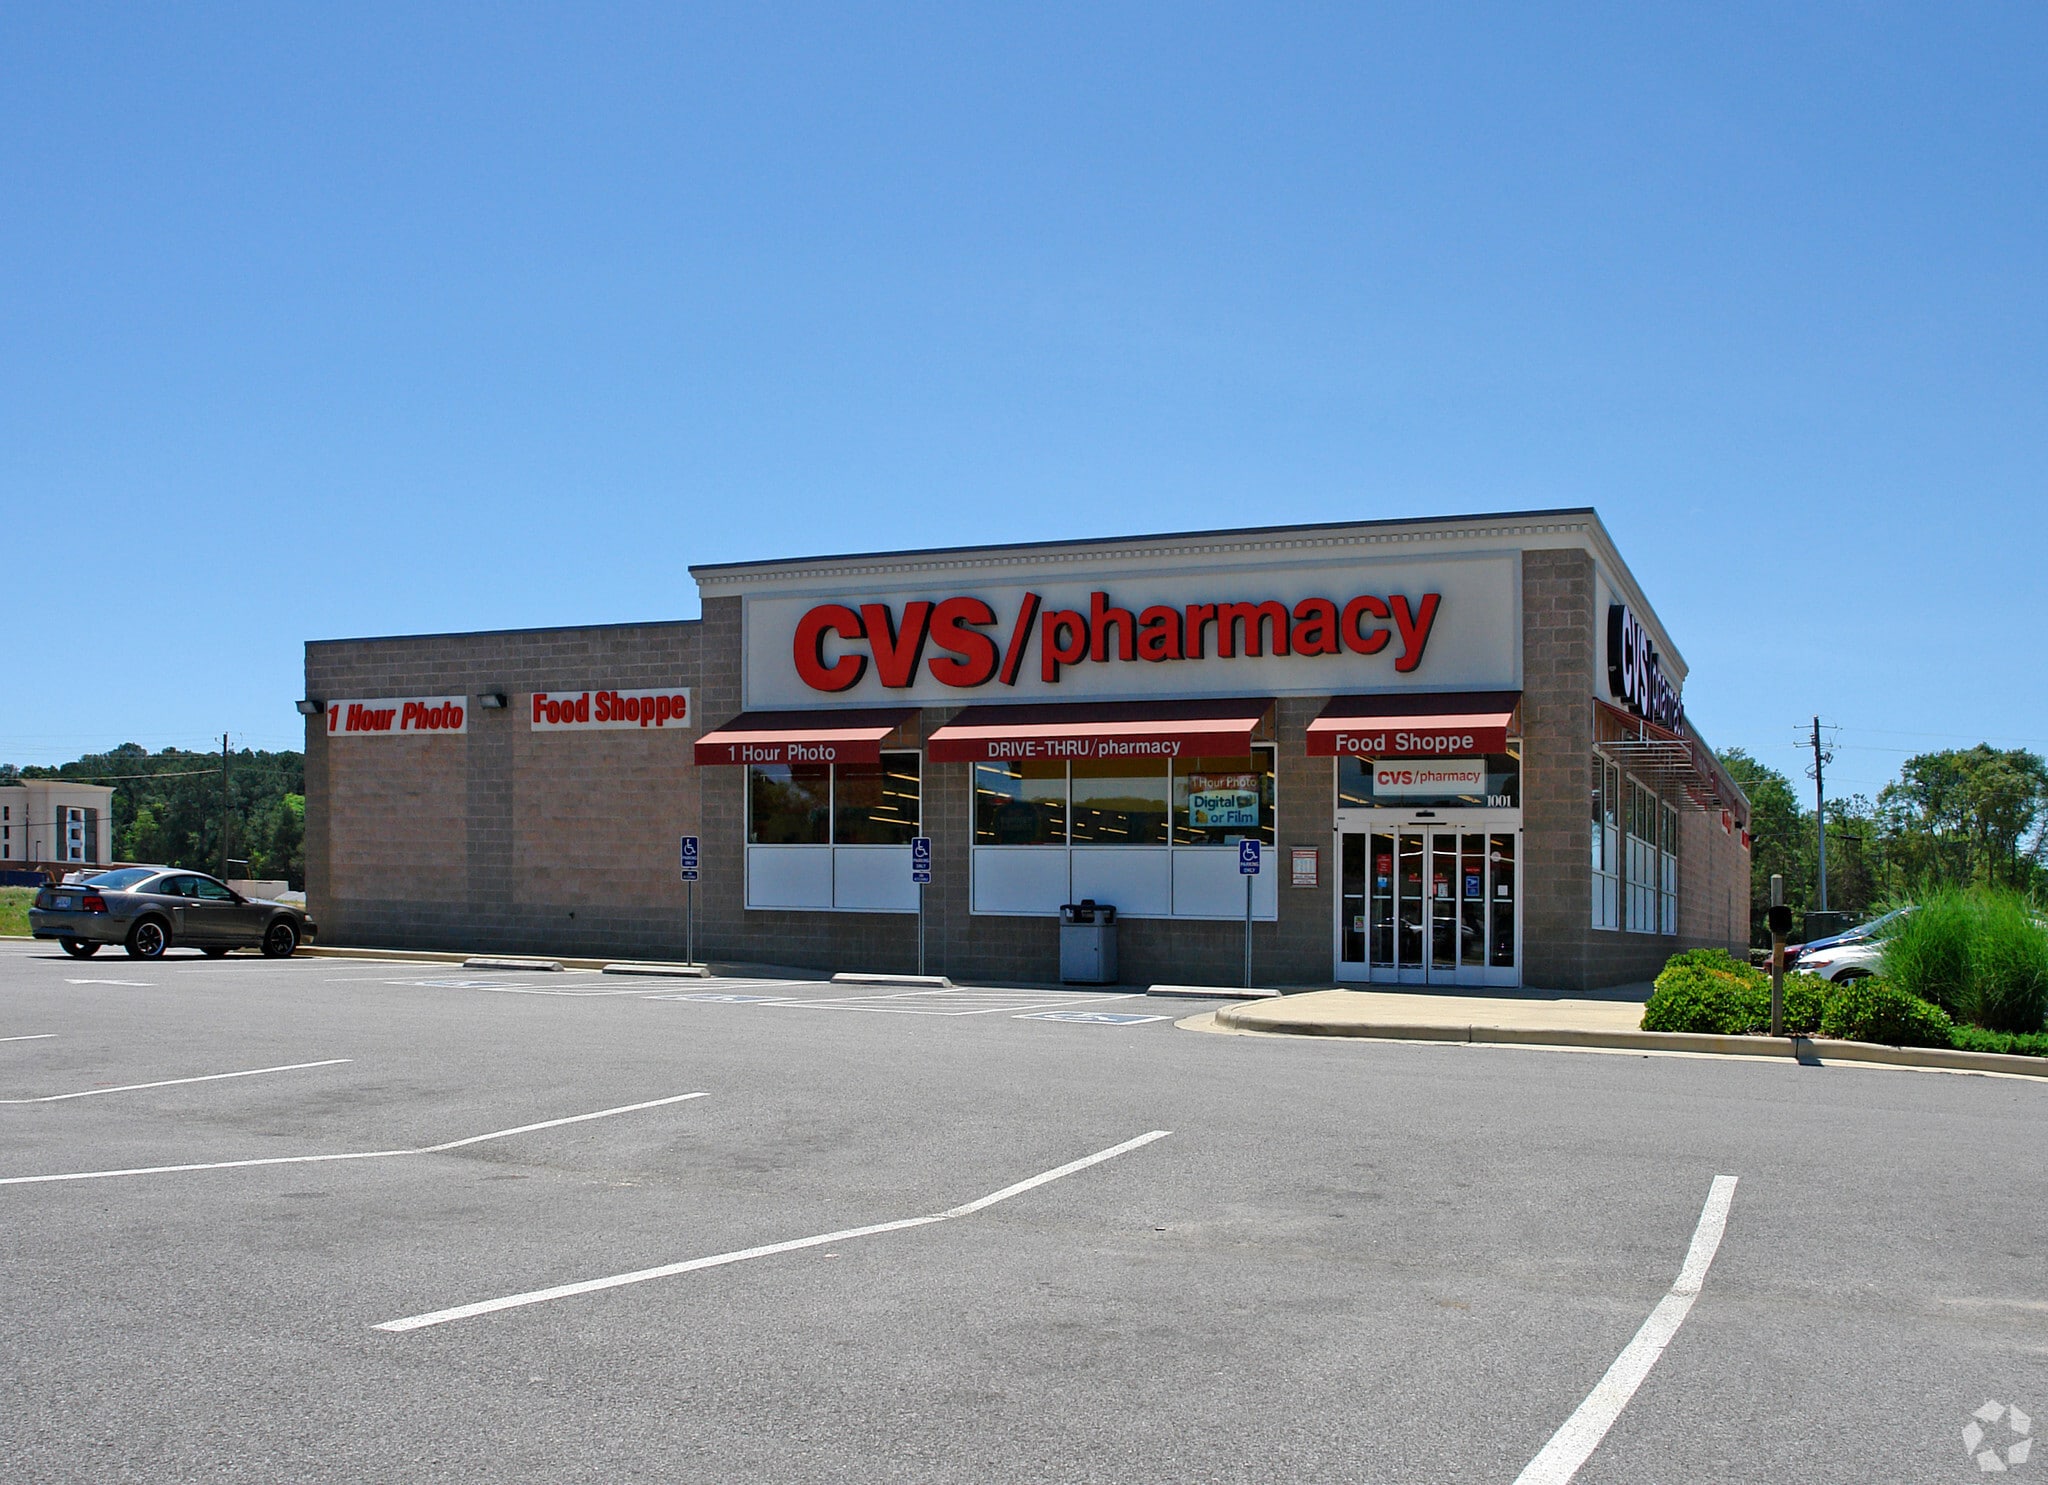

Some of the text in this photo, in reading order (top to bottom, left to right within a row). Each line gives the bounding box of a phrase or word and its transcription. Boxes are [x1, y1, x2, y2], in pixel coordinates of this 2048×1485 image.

[793, 592, 1441, 692] CVS/pharmacy
[328, 701, 464, 732] 1 Hour Photo
[532, 690, 687, 728] Food Shoppe
[988, 738, 1182, 758] DRIVE-THRU/pharmacy
[1336, 732, 1474, 753] Food Shoppe
[728, 744, 836, 762] 1 Hour Photo
[1200, 776, 1224, 788] Hour
[1226, 776, 1257, 788] Photo
[1377, 769, 1481, 786] CVS/pharmacy
[1194, 795, 1235, 811] Digital
[1486, 795, 1512, 808] 1001
[1211, 810, 1253, 823] or Film
